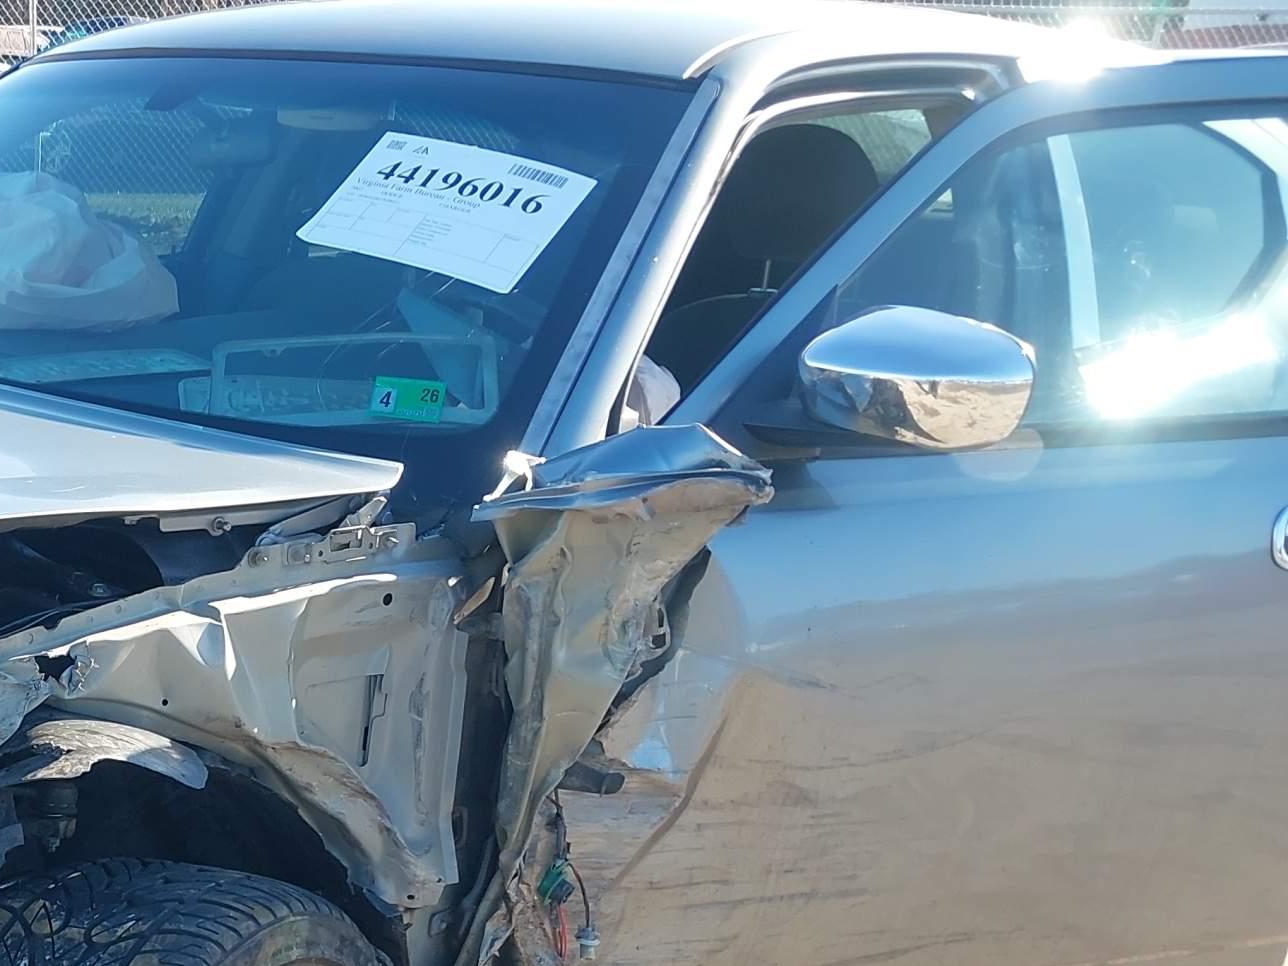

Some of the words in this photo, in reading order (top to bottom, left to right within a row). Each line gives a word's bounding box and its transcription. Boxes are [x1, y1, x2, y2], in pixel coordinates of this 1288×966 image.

[377, 160, 552, 214] 44196016
[390, 183, 414, 196] Farm
[452, 195, 482, 209] Group
[378, 390, 393, 408] 4
[419, 387, 441, 404] 26
